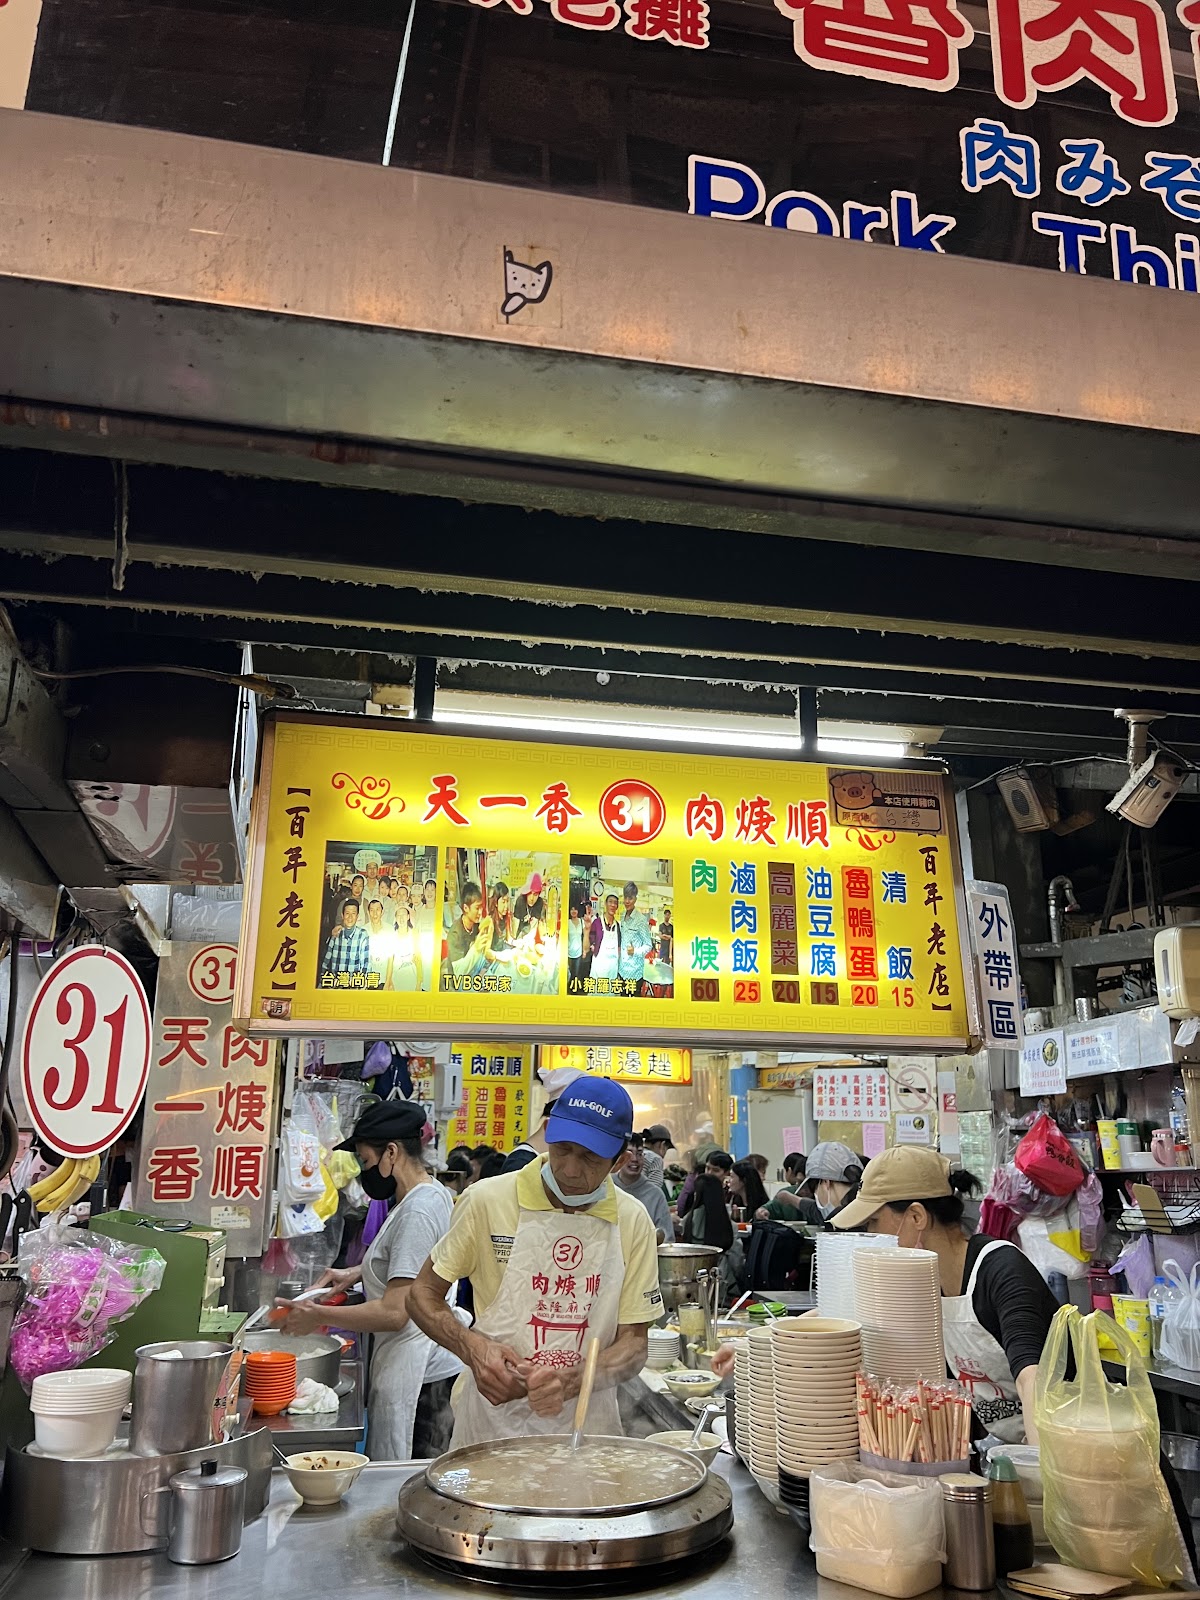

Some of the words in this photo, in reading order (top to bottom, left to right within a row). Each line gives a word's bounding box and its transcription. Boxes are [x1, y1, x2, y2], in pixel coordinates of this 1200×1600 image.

[421, 774, 584, 834] 天一香
[610, 794, 652, 833] 31
[730, 861, 759, 973] 滷肉飯
[769, 870, 797, 967] 高麗菜
[806, 866, 837, 977] 油豆腐
[845, 868, 876, 979] 魯鴨蛋
[200, 956, 236, 990] 31
[321, 971, 381, 989] 台灣尚青
[978, 901, 1018, 1040] 外帶區
[693, 980, 717, 1000] 60
[735, 982, 759, 1001] 25
[774, 982, 798, 1003] 20
[813, 983, 837, 1004] 15
[854, 986, 876, 1005] 20
[891, 986, 914, 1008] 15
[43, 982, 129, 1115] 31
[148, 1018, 209, 1202] 天一香
[474, 1087, 489, 1136] 油豆腐
[568, 1097, 614, 1118] LKK-GOLF
[879, 1110, 888, 1118] 20
[492, 1141, 504, 1150] 20
[556, 1243, 580, 1264] 31
